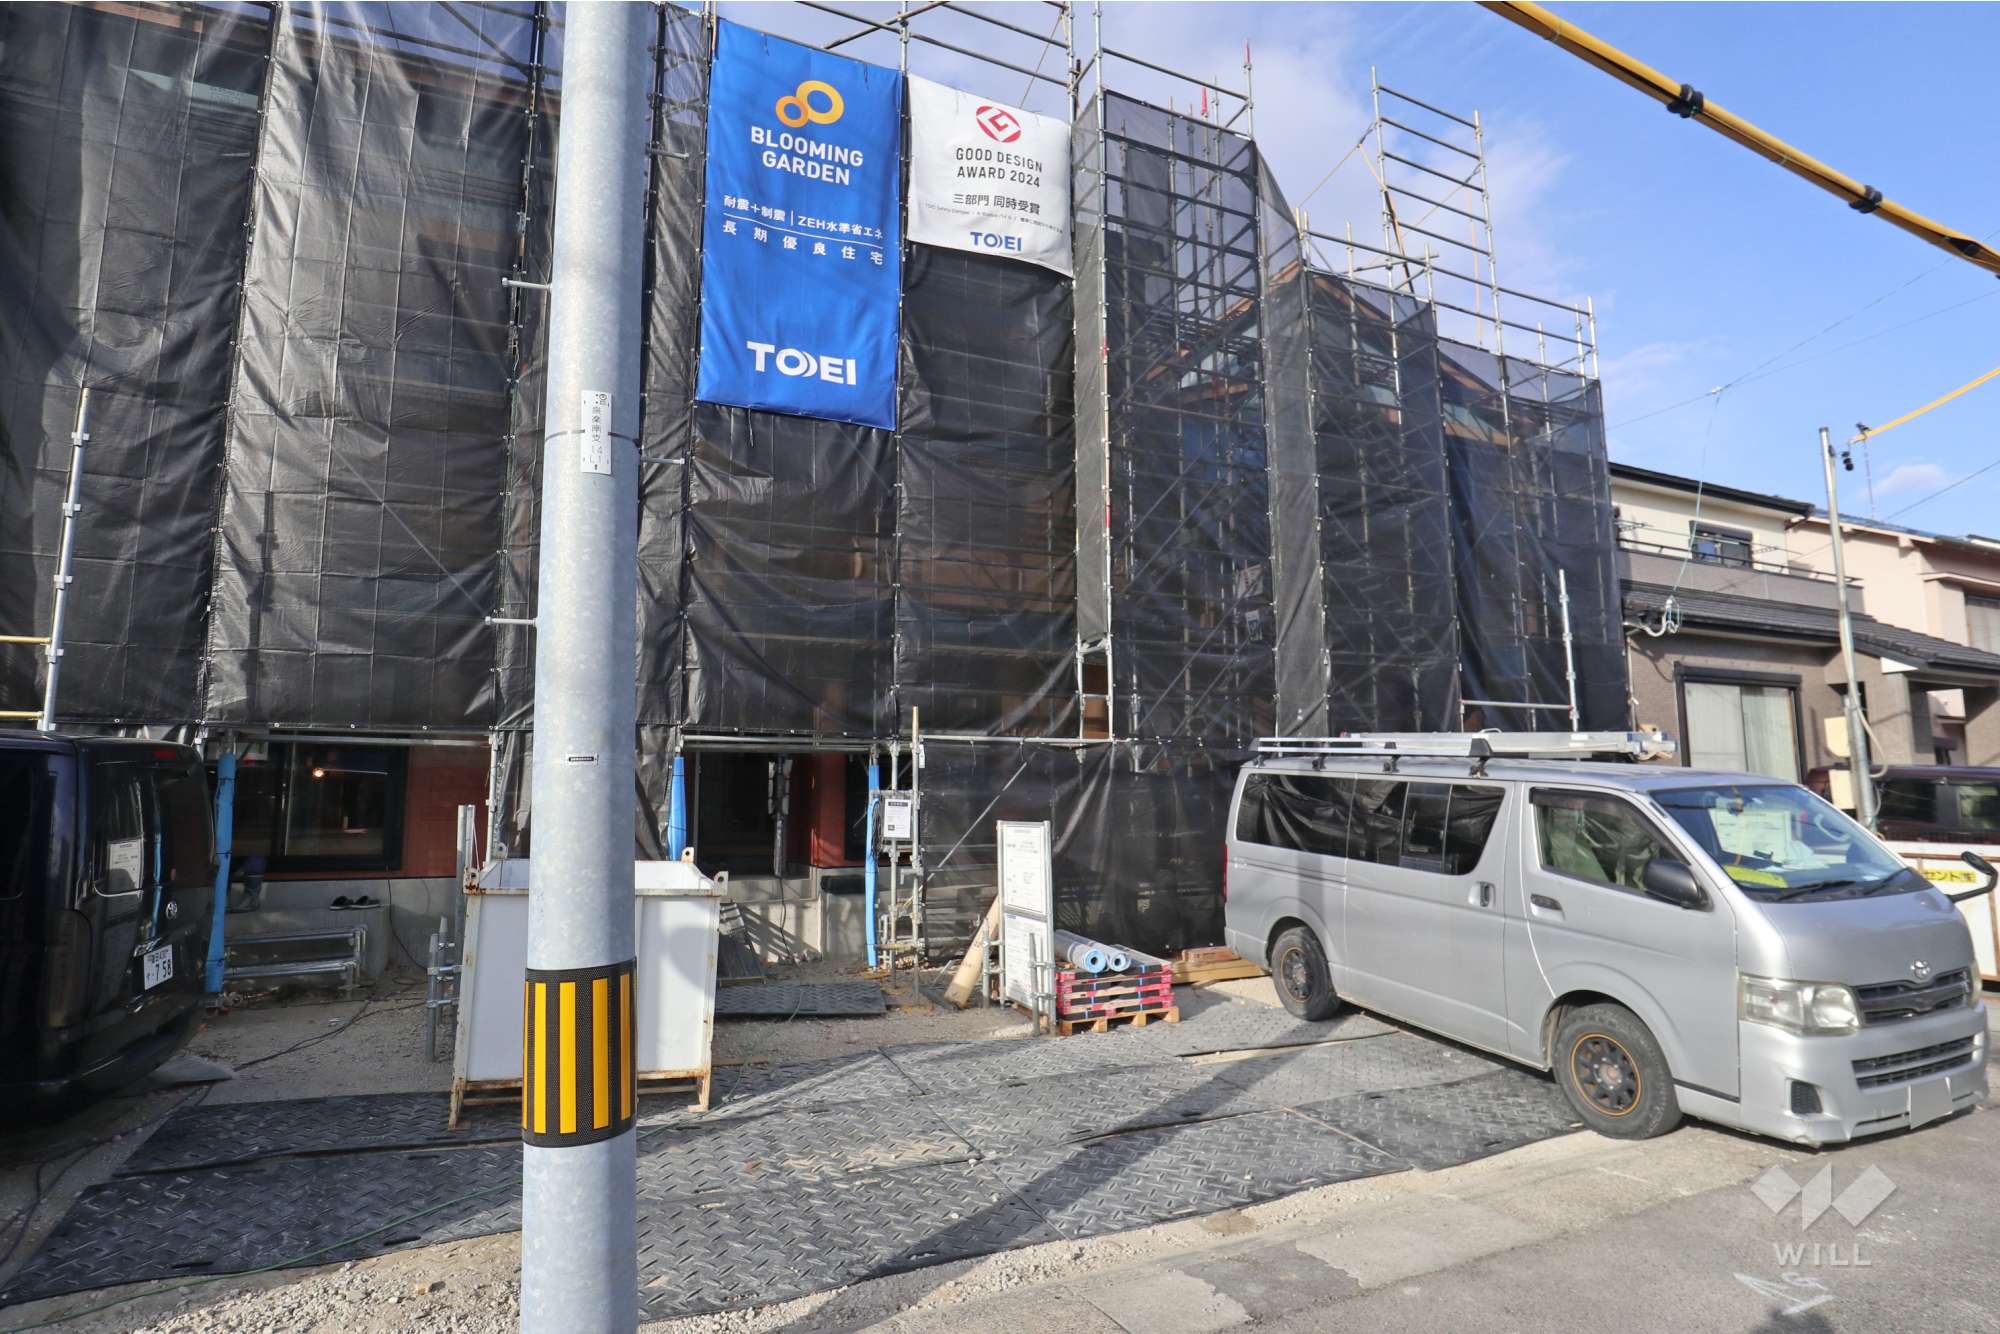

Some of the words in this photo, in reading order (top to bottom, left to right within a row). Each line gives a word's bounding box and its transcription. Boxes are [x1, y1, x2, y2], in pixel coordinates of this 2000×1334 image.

[751, 126, 864, 167] BLOOMING
[956, 147, 992, 161] GOOD
[997, 151, 1042, 173] DESIGN
[762, 151, 850, 186] GARDEN
[957, 166, 1006, 180] AWARD
[1010, 170, 1040, 188] 2024
[952, 193, 990, 207] 三部門
[994, 194, 1040, 216] 同時受賞
[723, 220, 883, 265] 長期優良住宅
[970, 231, 1022, 252] TOEI
[746, 341, 857, 385] TOEI
